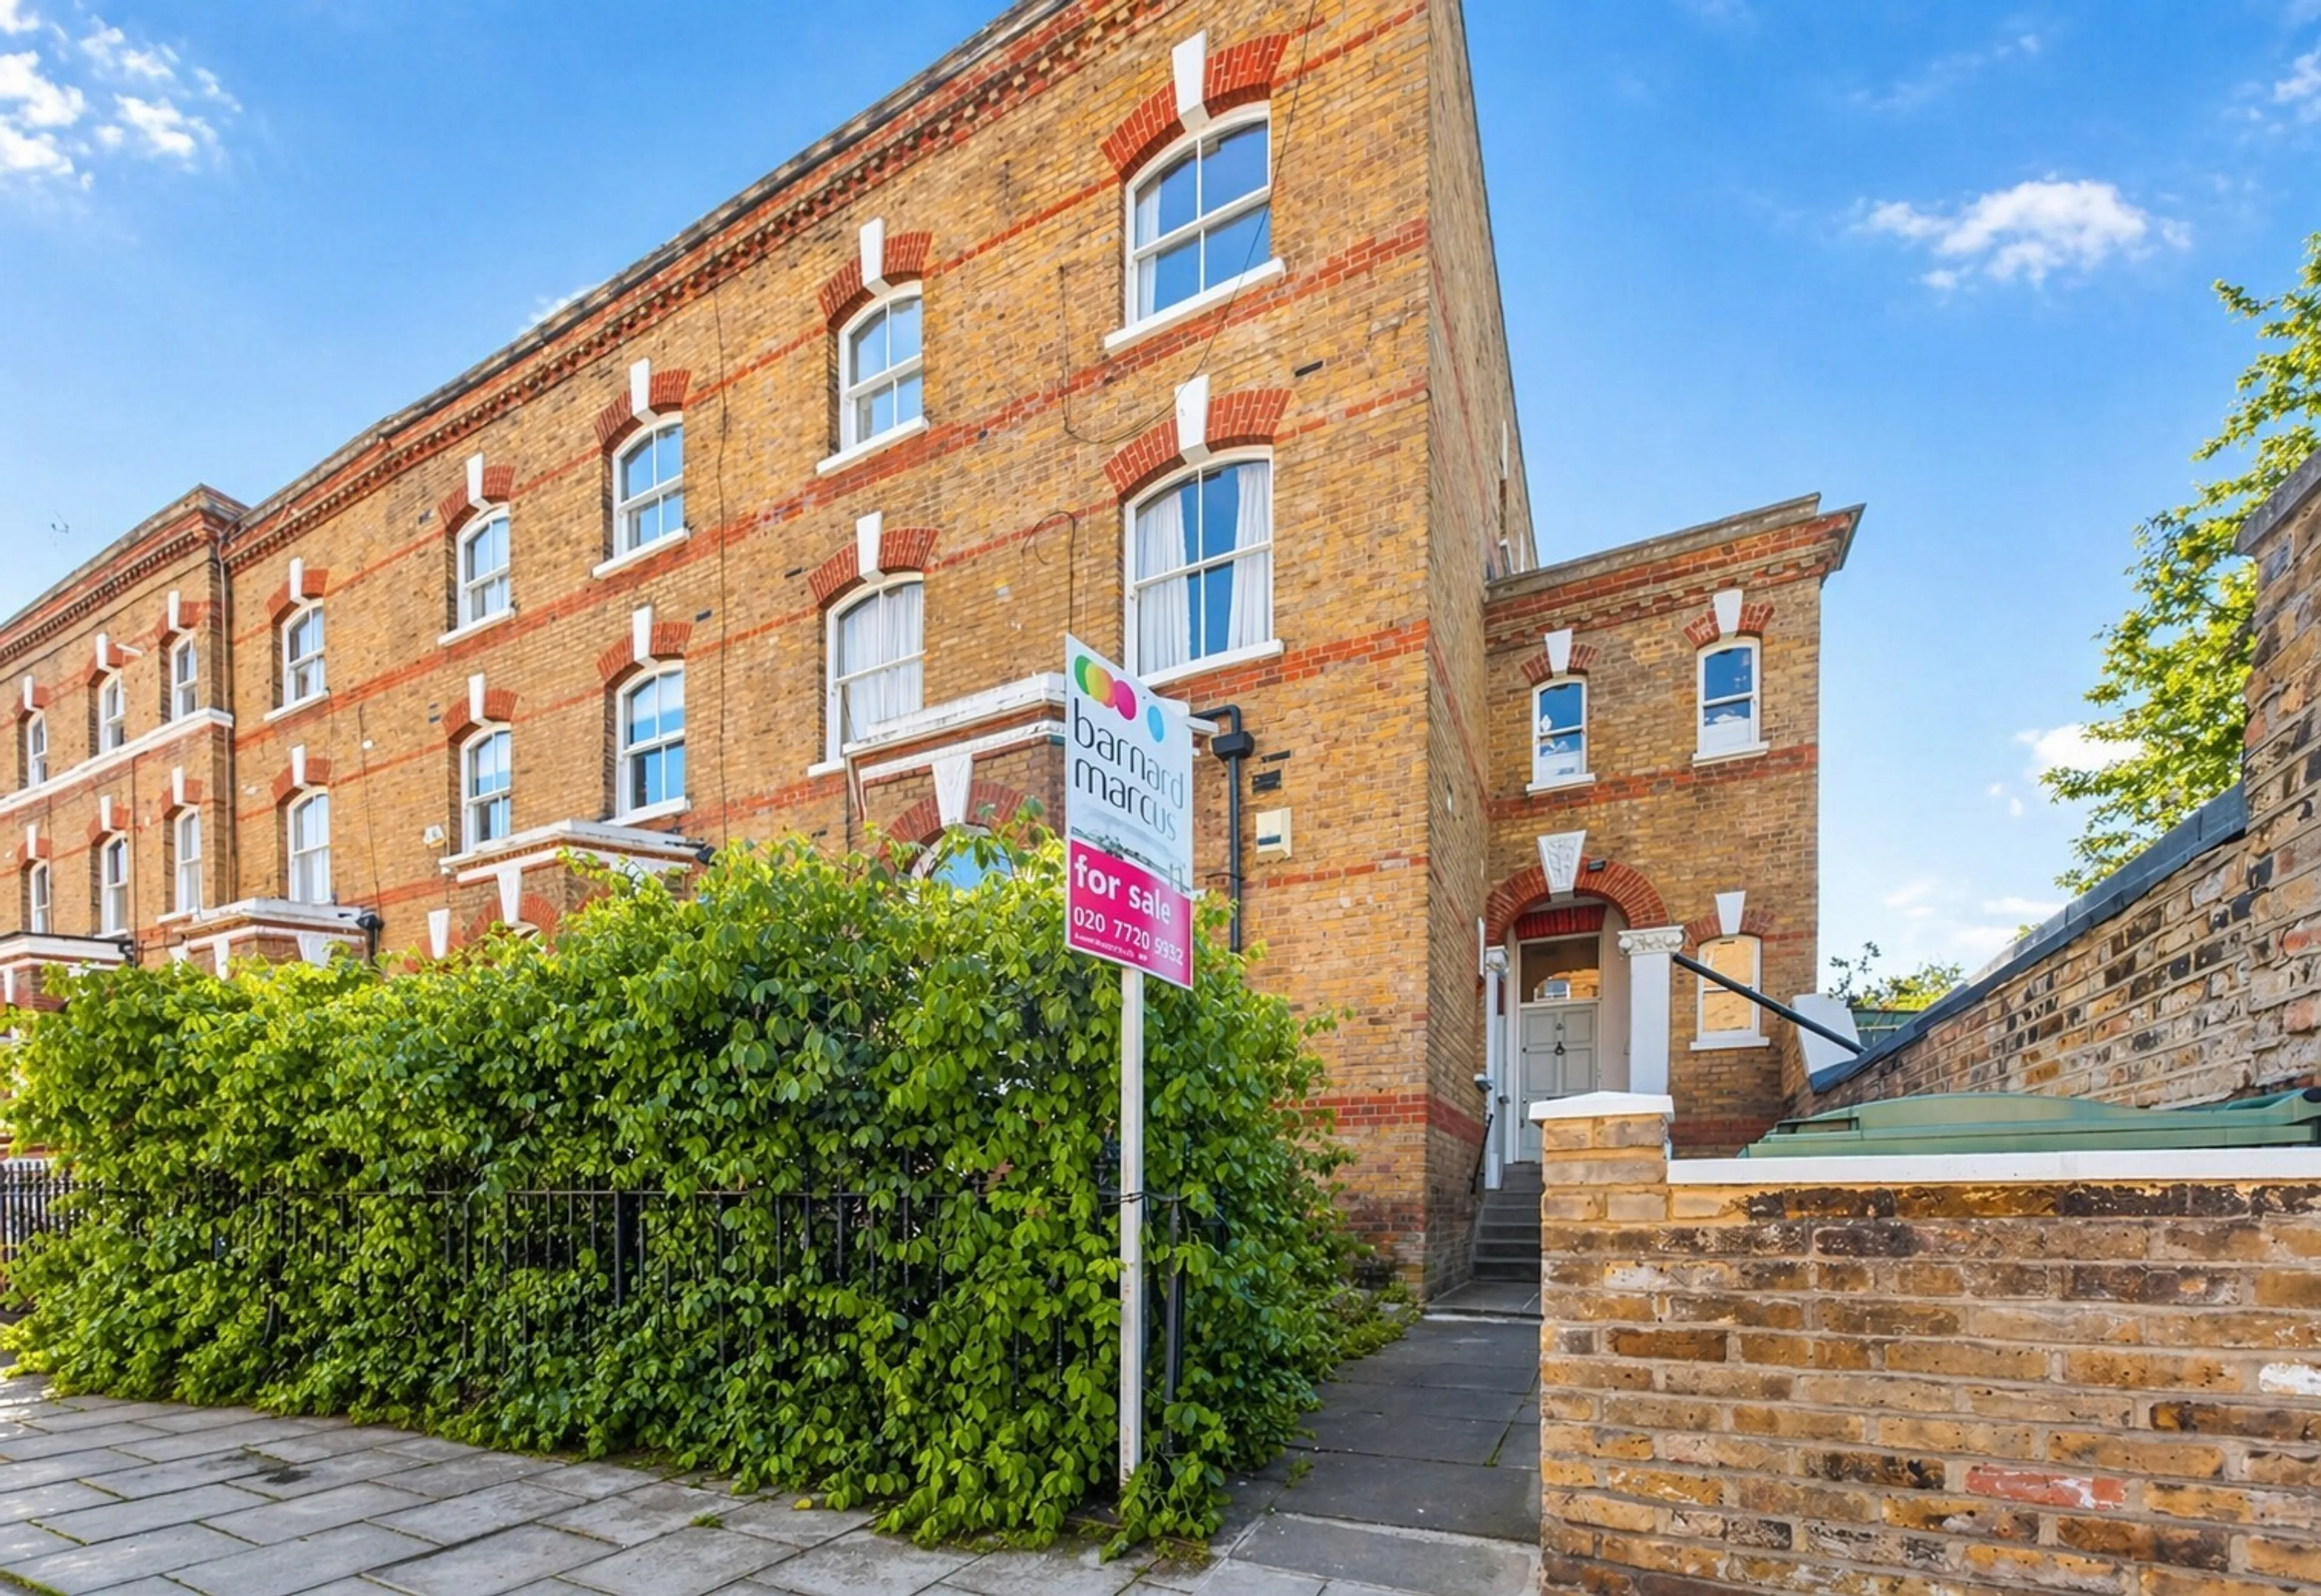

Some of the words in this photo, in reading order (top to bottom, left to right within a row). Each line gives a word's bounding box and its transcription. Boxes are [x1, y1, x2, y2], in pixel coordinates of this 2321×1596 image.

[1074, 697, 1183, 809] barnard
[1075, 758, 1176, 841] marcus
[1073, 906, 1105, 933] 020
[1113, 919, 1150, 950] 7720
[1075, 854, 1121, 900] for
[1128, 885, 1171, 925] sale
